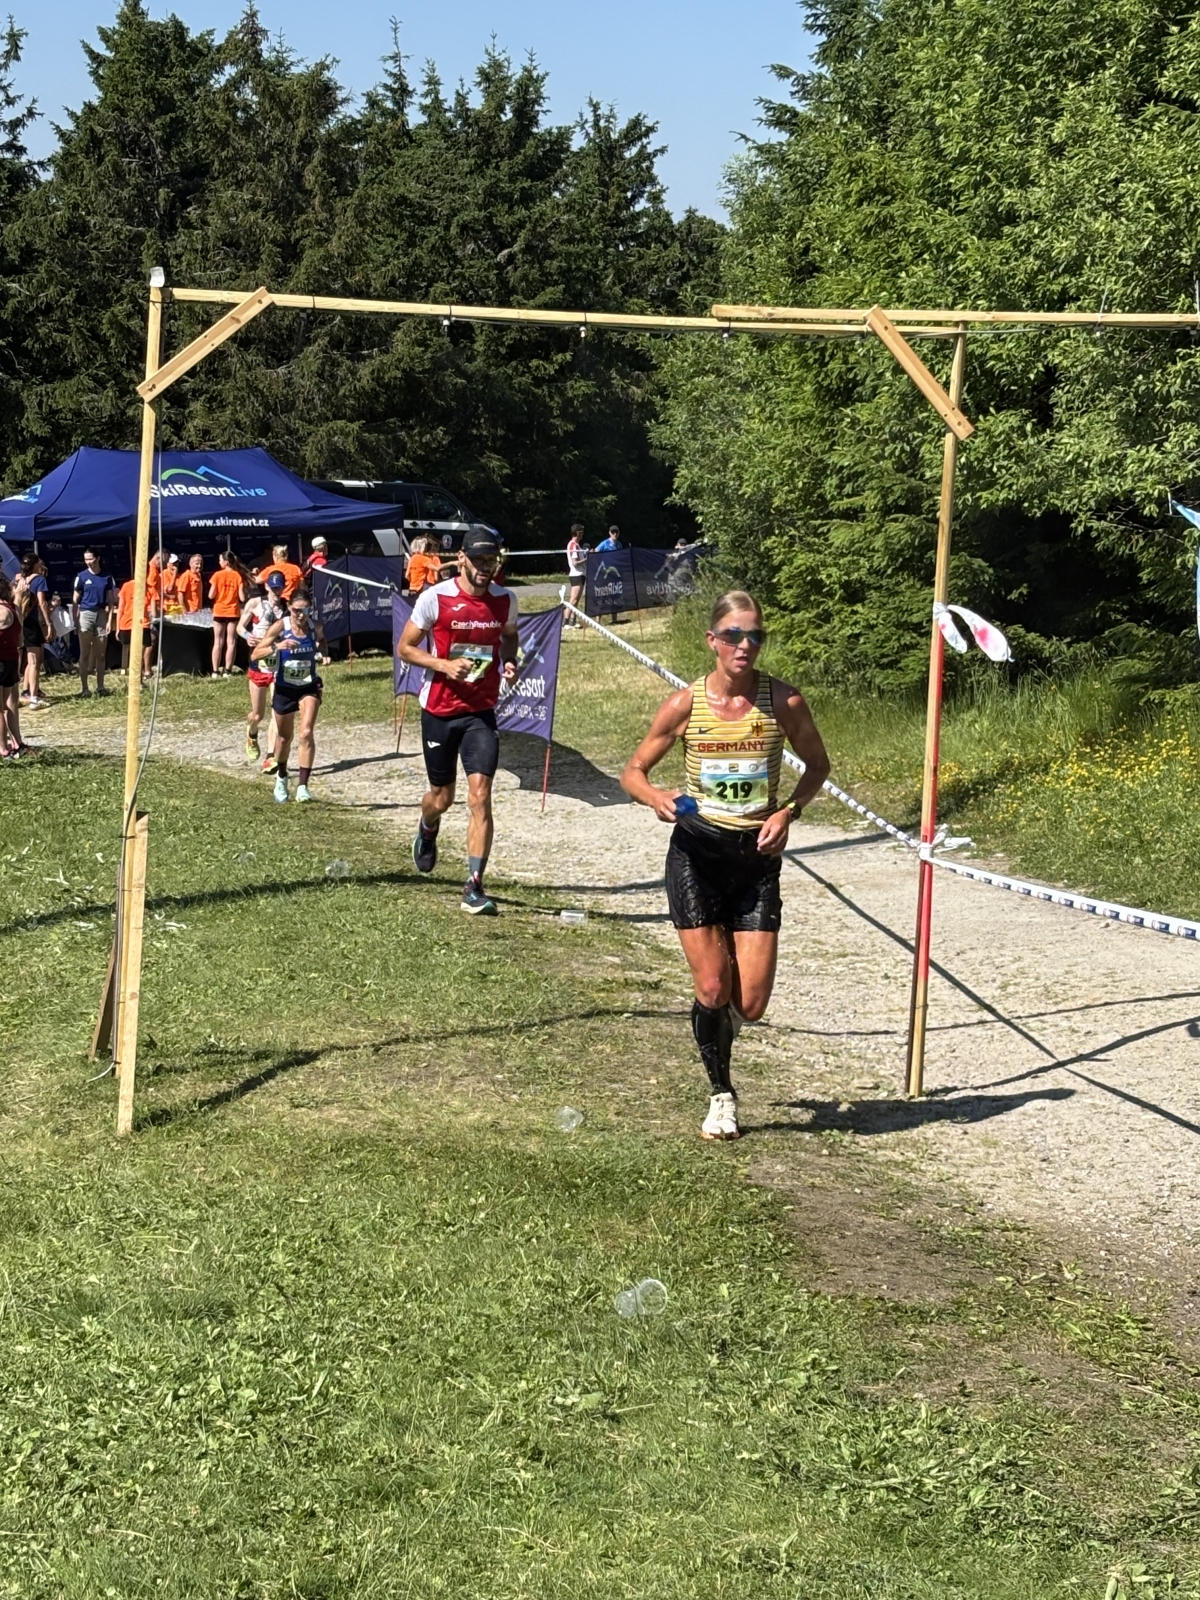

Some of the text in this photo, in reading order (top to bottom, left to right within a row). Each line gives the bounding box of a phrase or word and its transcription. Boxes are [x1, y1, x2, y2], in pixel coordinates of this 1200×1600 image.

[150, 484, 267, 497] SkiResortLive
[188, 517, 270, 527] www.skiresort.cz
[451, 620, 502, 630] CzechRepublic
[289, 646, 314, 655] ITALIA
[290, 669, 305, 677] 227
[697, 741, 765, 753] GERMANY
[715, 781, 753, 799] 219
